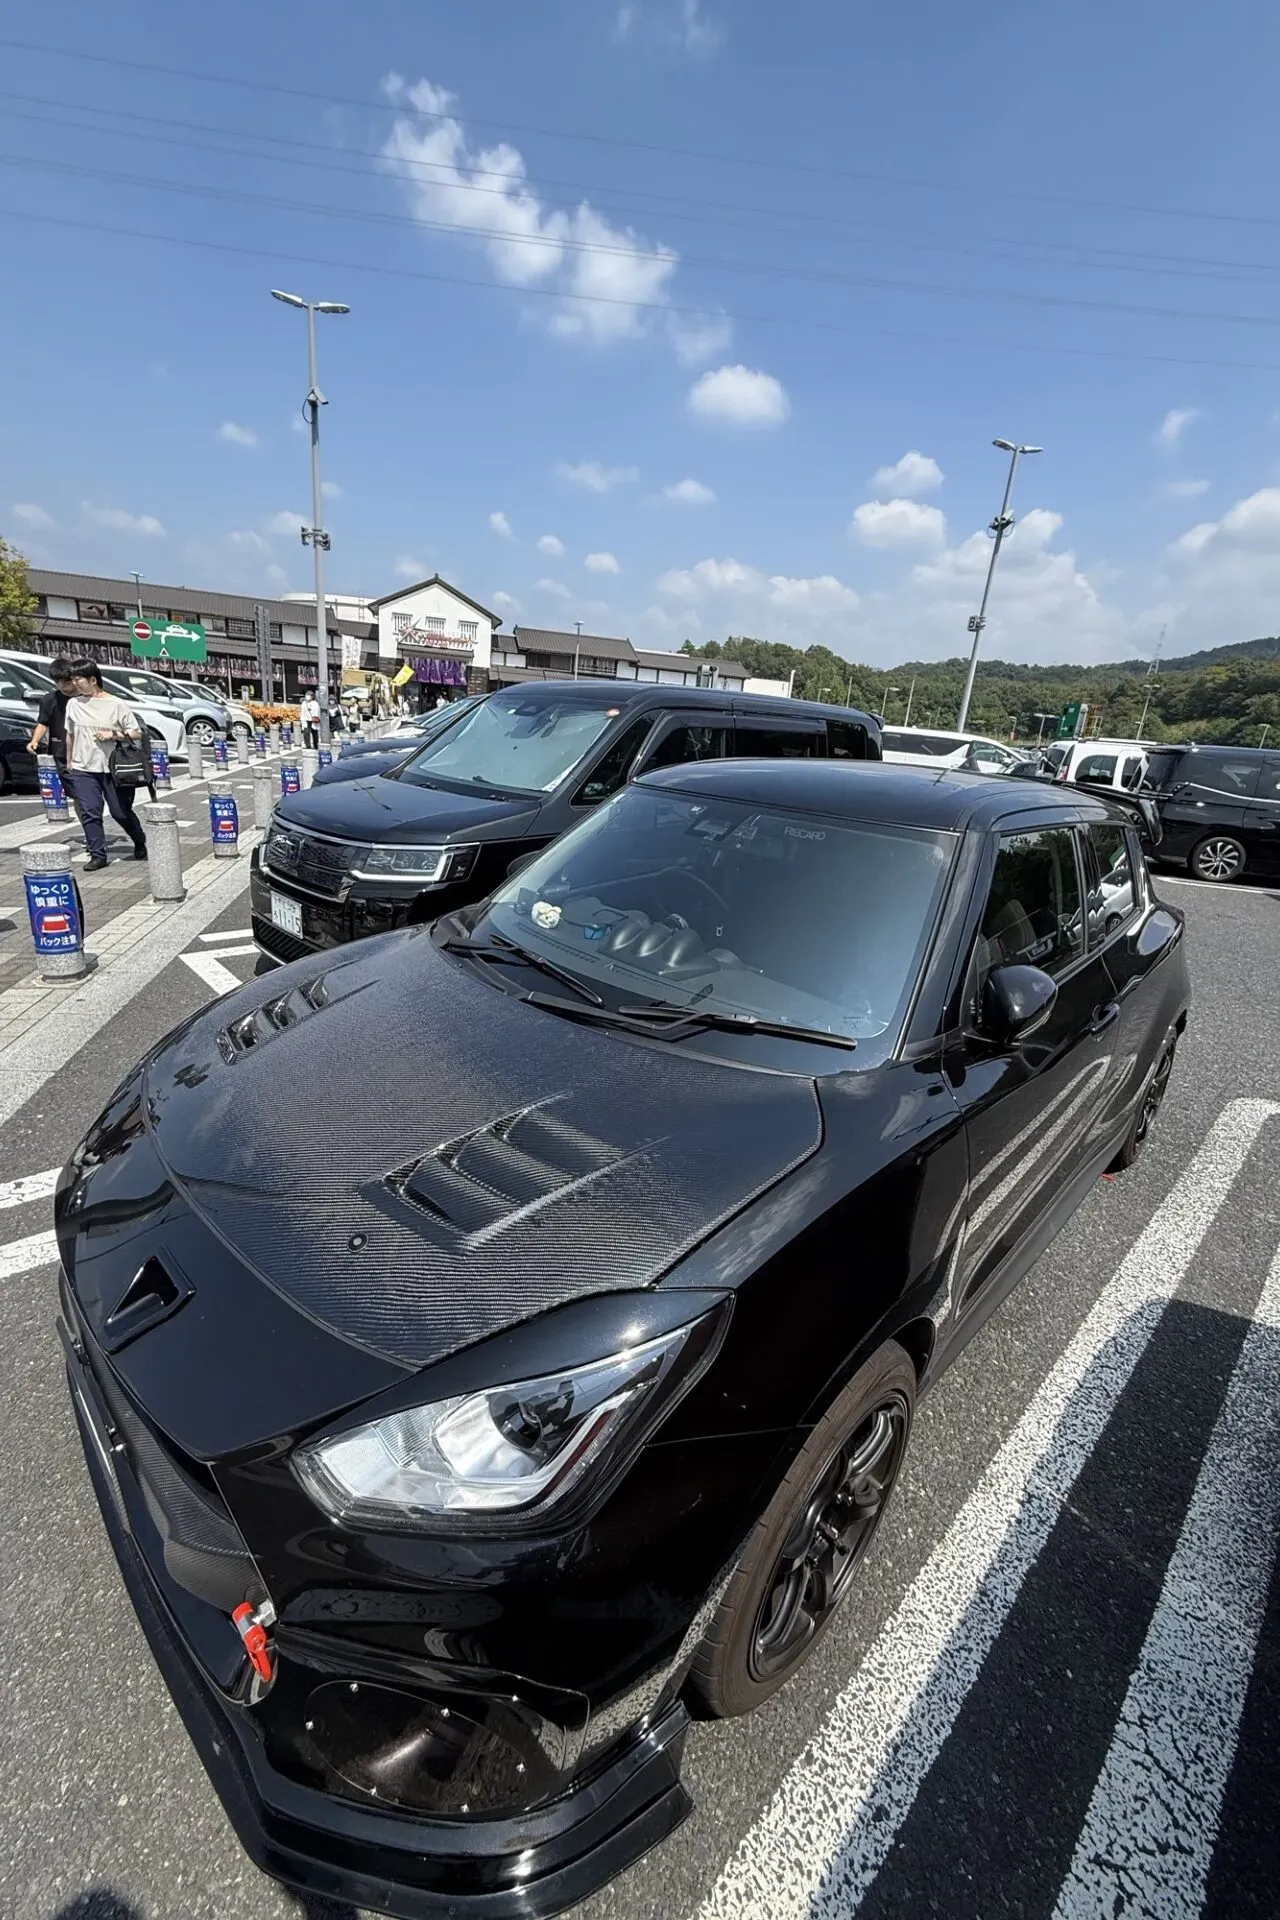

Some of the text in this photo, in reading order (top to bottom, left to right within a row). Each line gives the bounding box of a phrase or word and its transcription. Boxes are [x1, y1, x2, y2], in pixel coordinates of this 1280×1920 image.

[784, 826, 826, 840] RECARO
[30, 884, 70, 895] ゆっくり
[35, 896, 70, 907] 慎重に
[40, 934, 77, 947] バック注意
